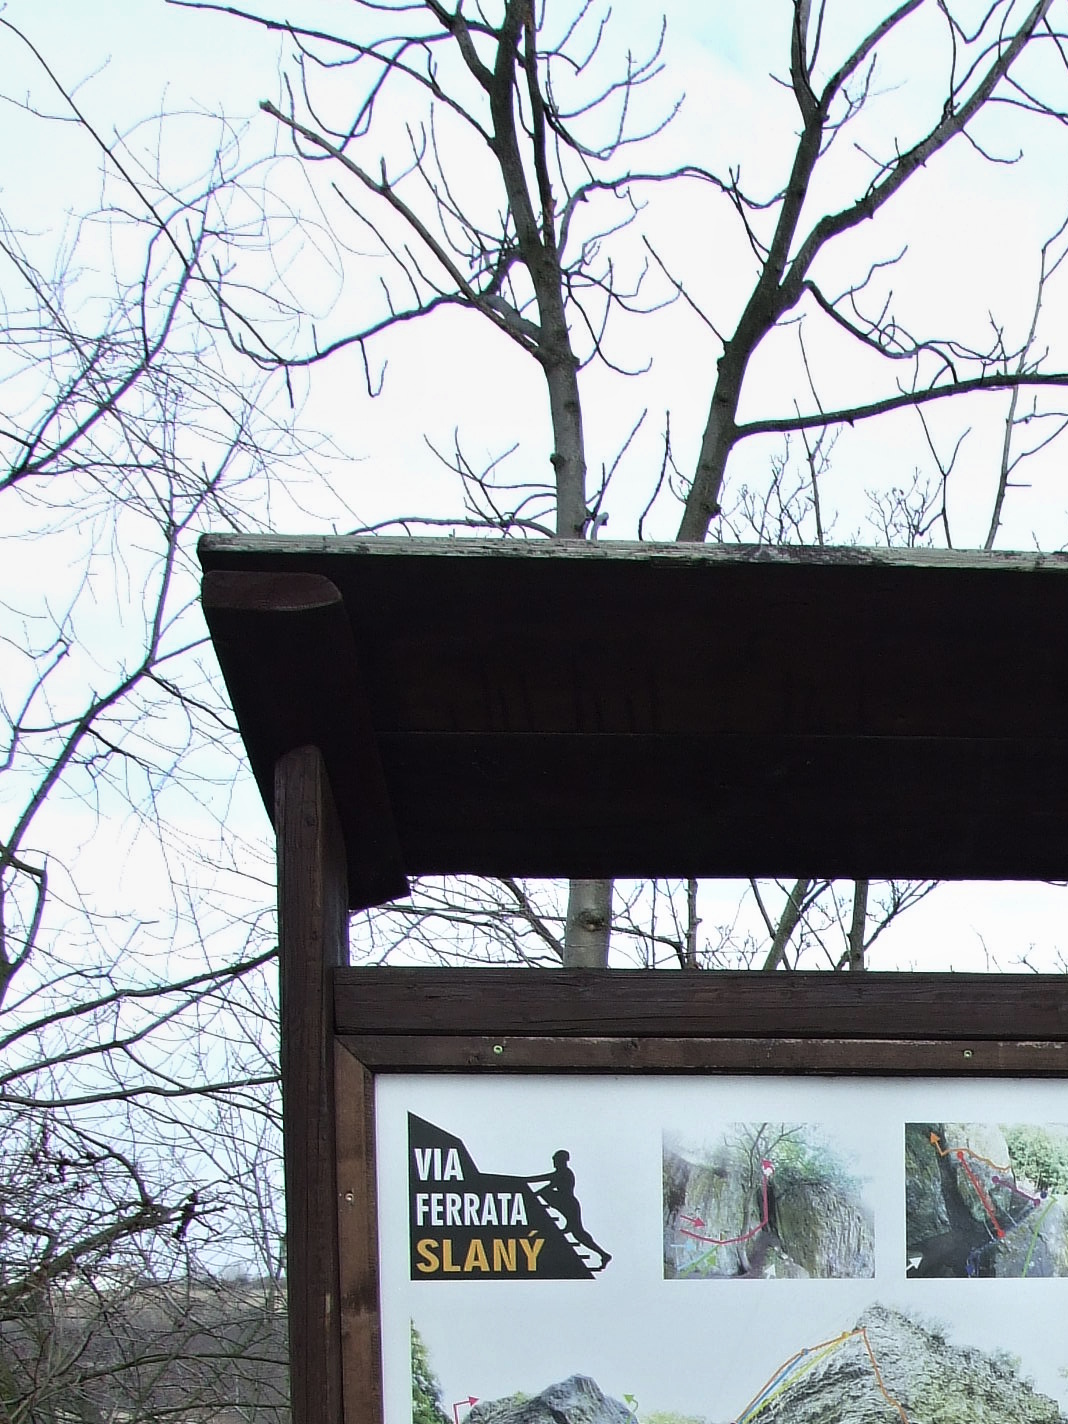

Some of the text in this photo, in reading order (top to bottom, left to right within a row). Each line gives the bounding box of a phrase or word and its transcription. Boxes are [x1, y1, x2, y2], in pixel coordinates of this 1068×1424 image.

[414, 1148, 464, 1181] VIA
[416, 1192, 528, 1226] FERRATA
[416, 1230, 545, 1273] SLANÝ
